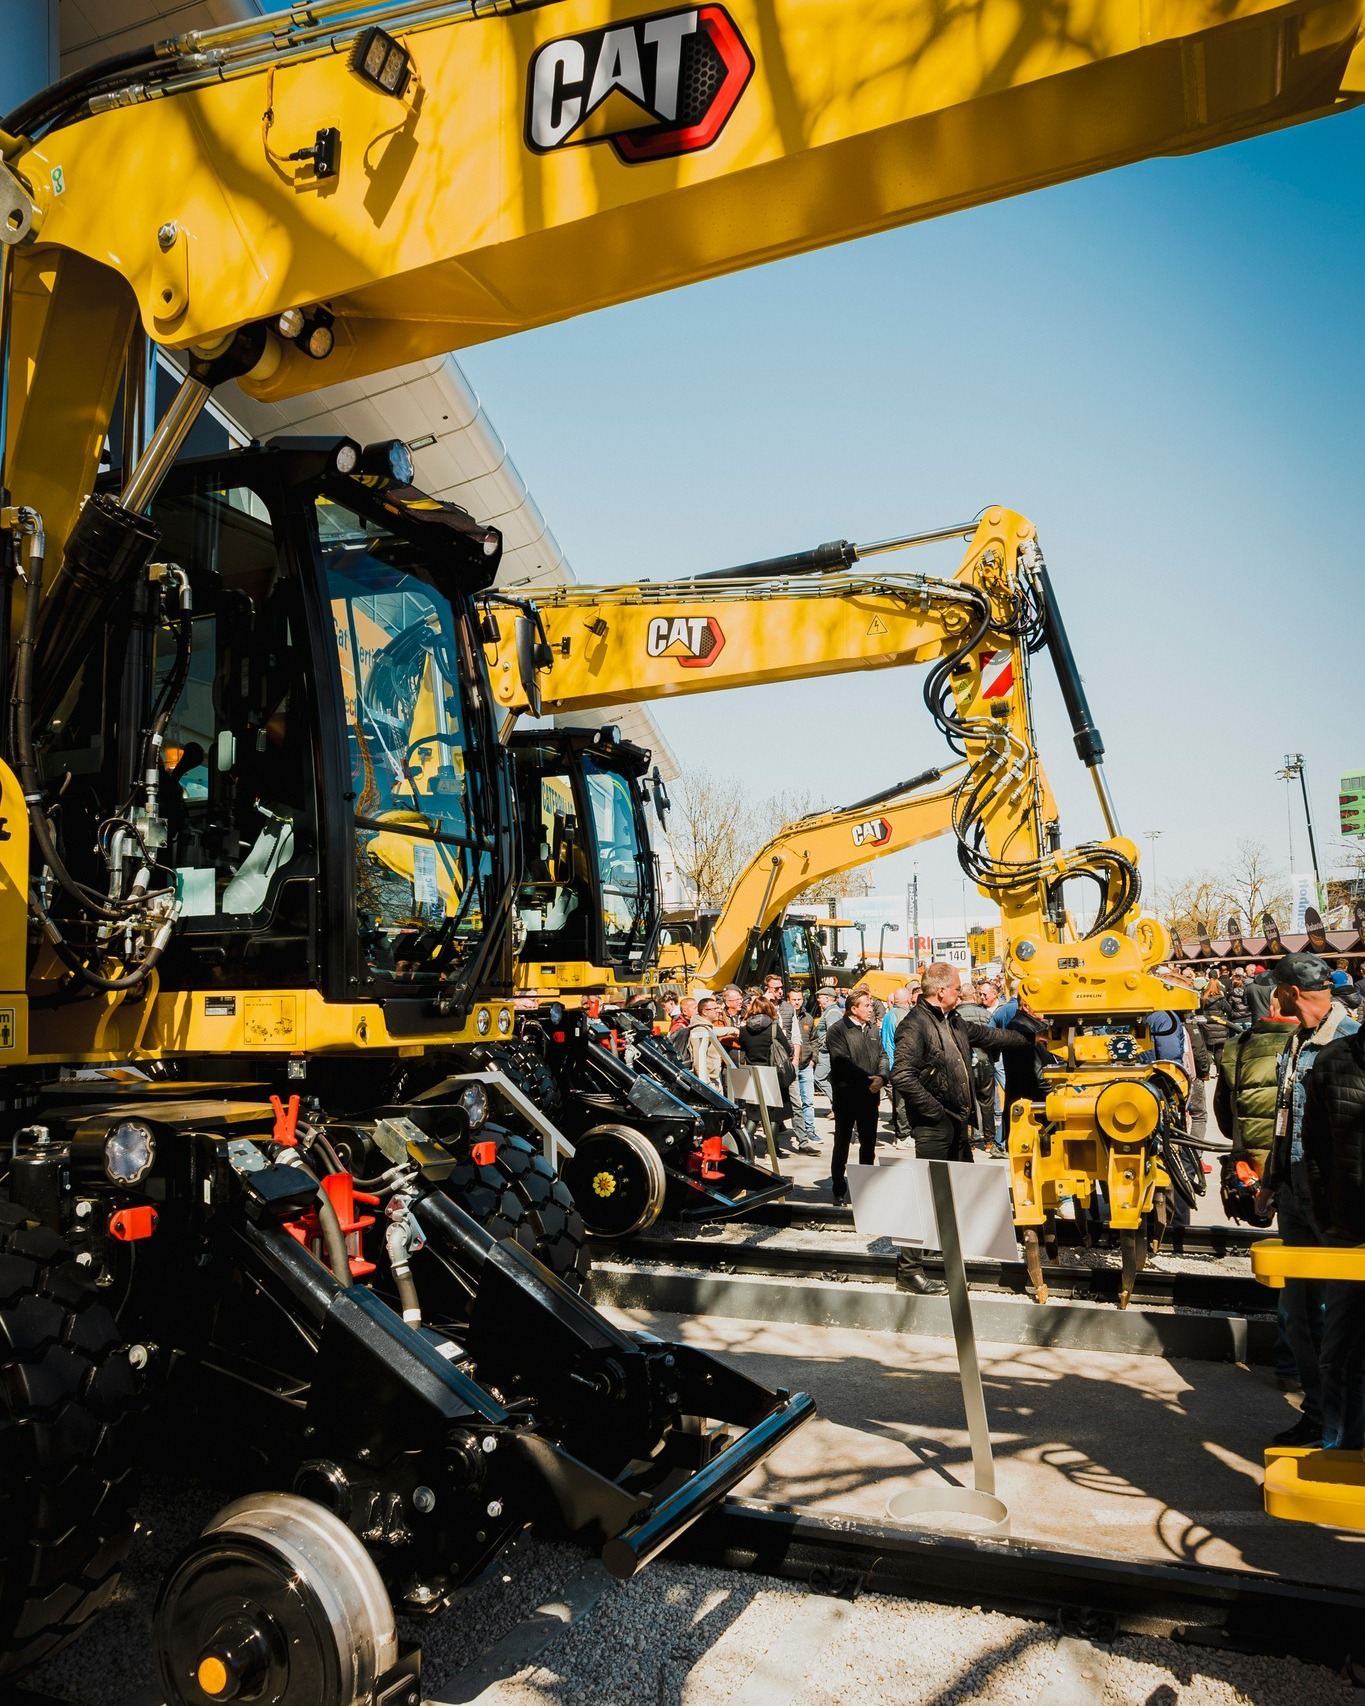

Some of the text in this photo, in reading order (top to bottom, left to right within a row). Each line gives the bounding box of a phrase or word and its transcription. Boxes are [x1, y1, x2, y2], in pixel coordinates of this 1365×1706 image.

[532, 10, 698, 147] CAT
[647, 618, 707, 656] CAT
[852, 819, 881, 846] CAT
[949, 950, 966, 961] 140
